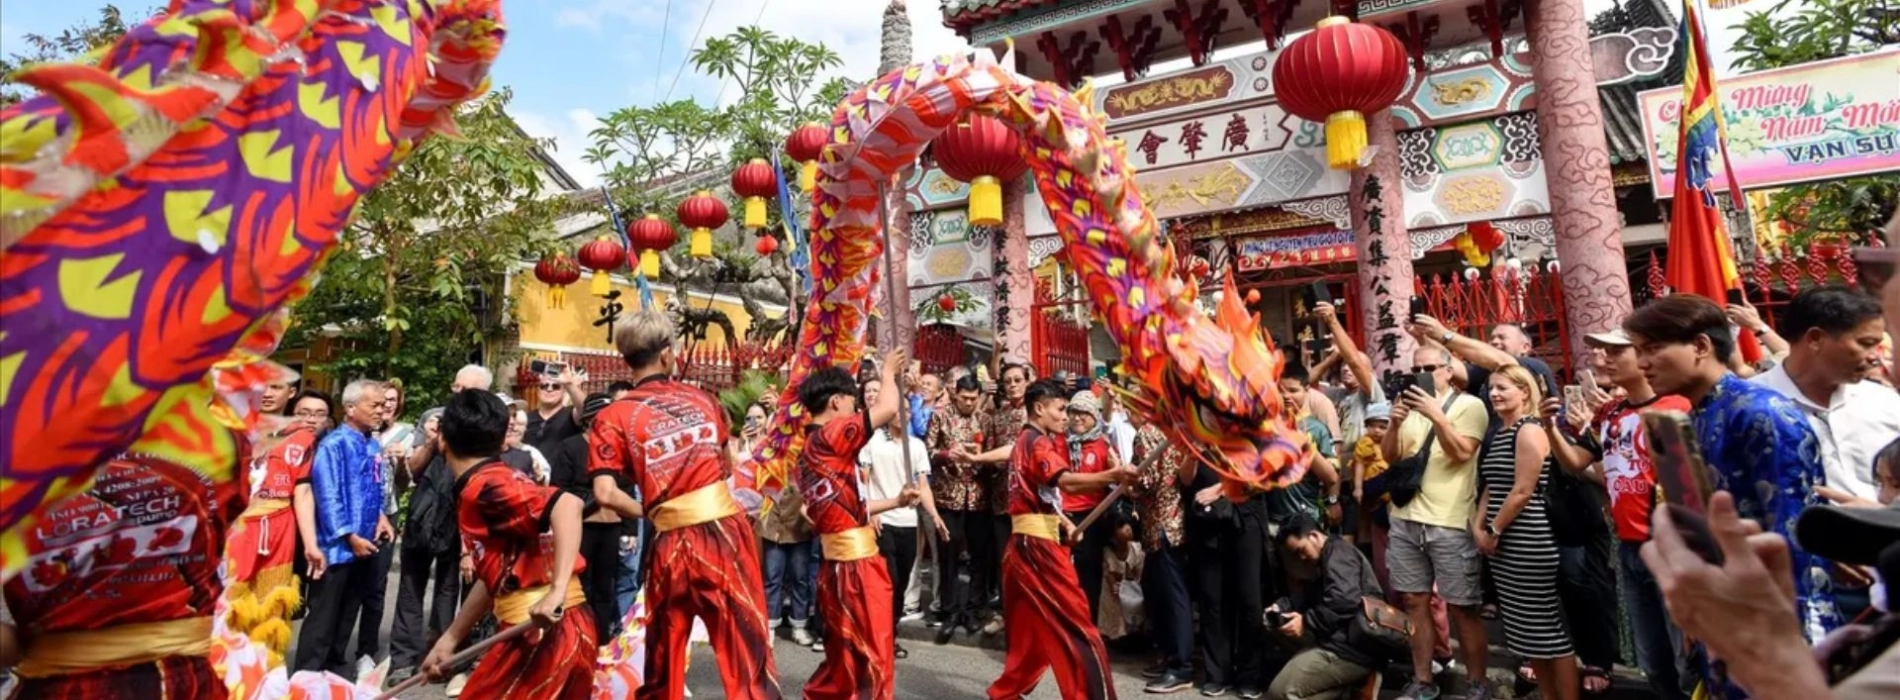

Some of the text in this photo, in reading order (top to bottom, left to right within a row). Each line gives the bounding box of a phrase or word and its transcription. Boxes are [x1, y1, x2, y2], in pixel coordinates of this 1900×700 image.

[1786, 131, 1894, 163] VẠN SỰ
[36, 495, 180, 541] LORATECH
[136, 509, 177, 526] pump
